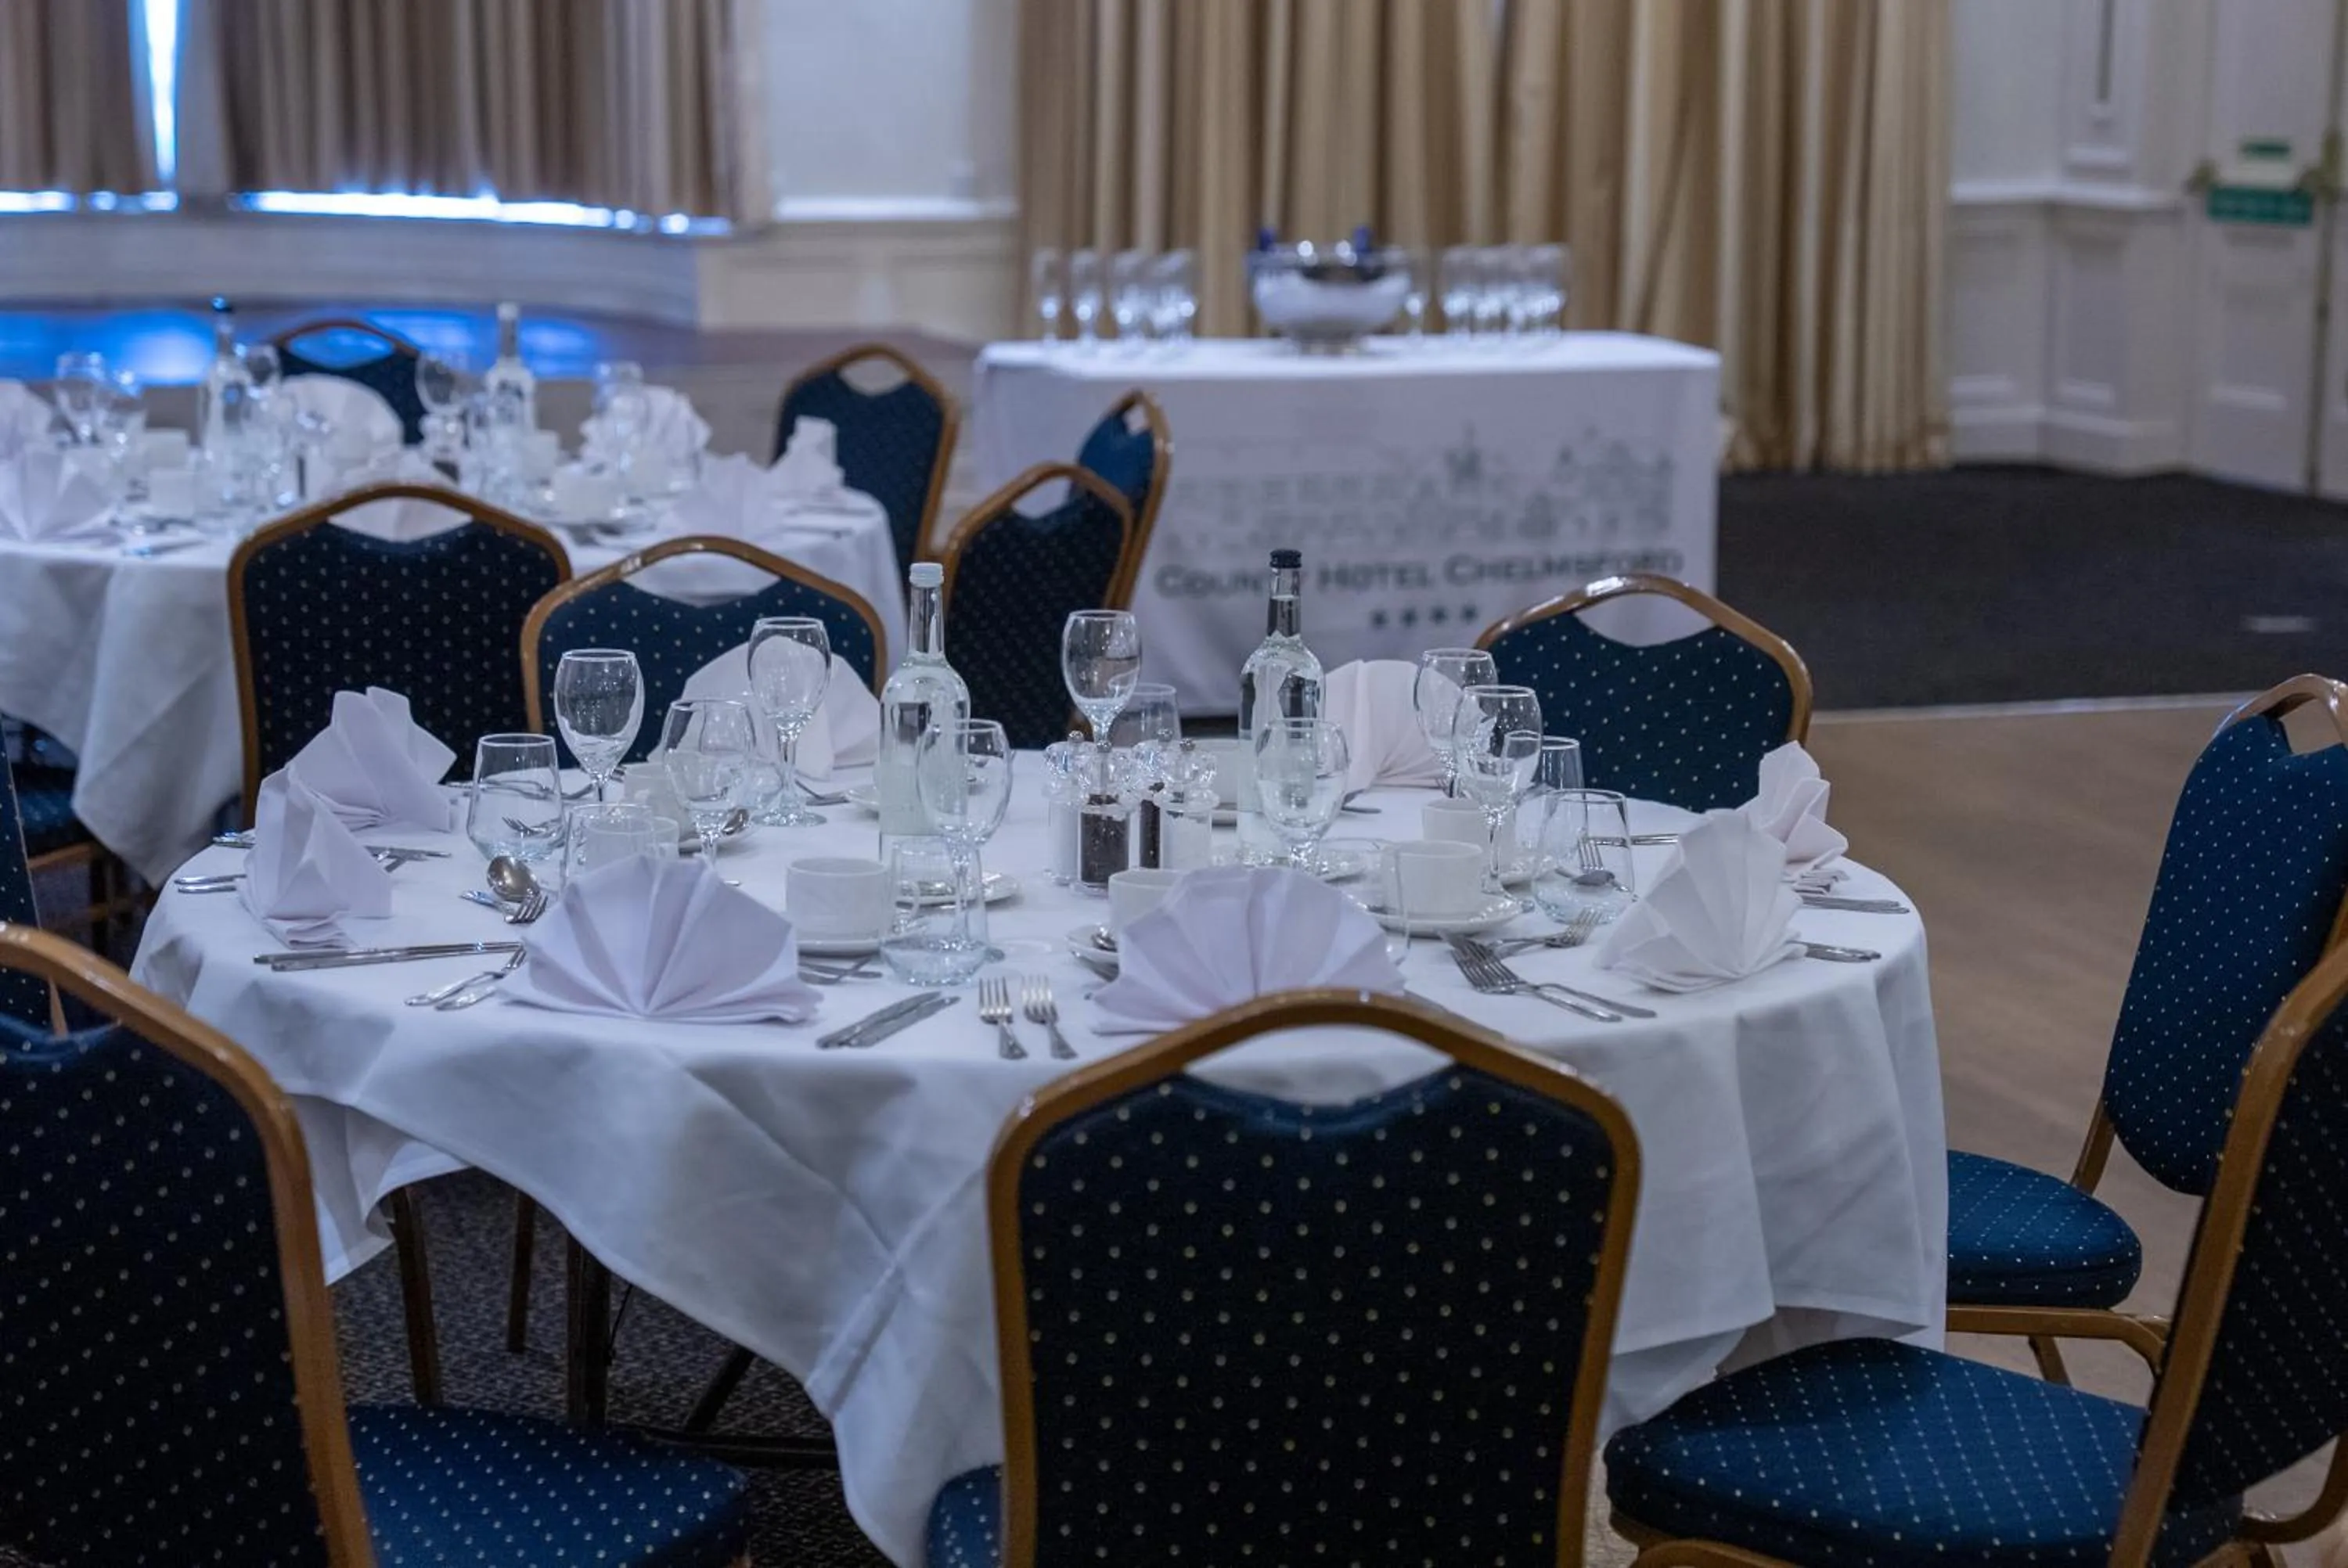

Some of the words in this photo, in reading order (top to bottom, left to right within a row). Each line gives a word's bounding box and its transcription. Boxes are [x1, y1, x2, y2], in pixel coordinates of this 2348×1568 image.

[1154, 562, 1308, 599] COUN
[1316, 559, 1434, 593] HOTEL
[1443, 548, 1685, 586] CHELMSFORD
